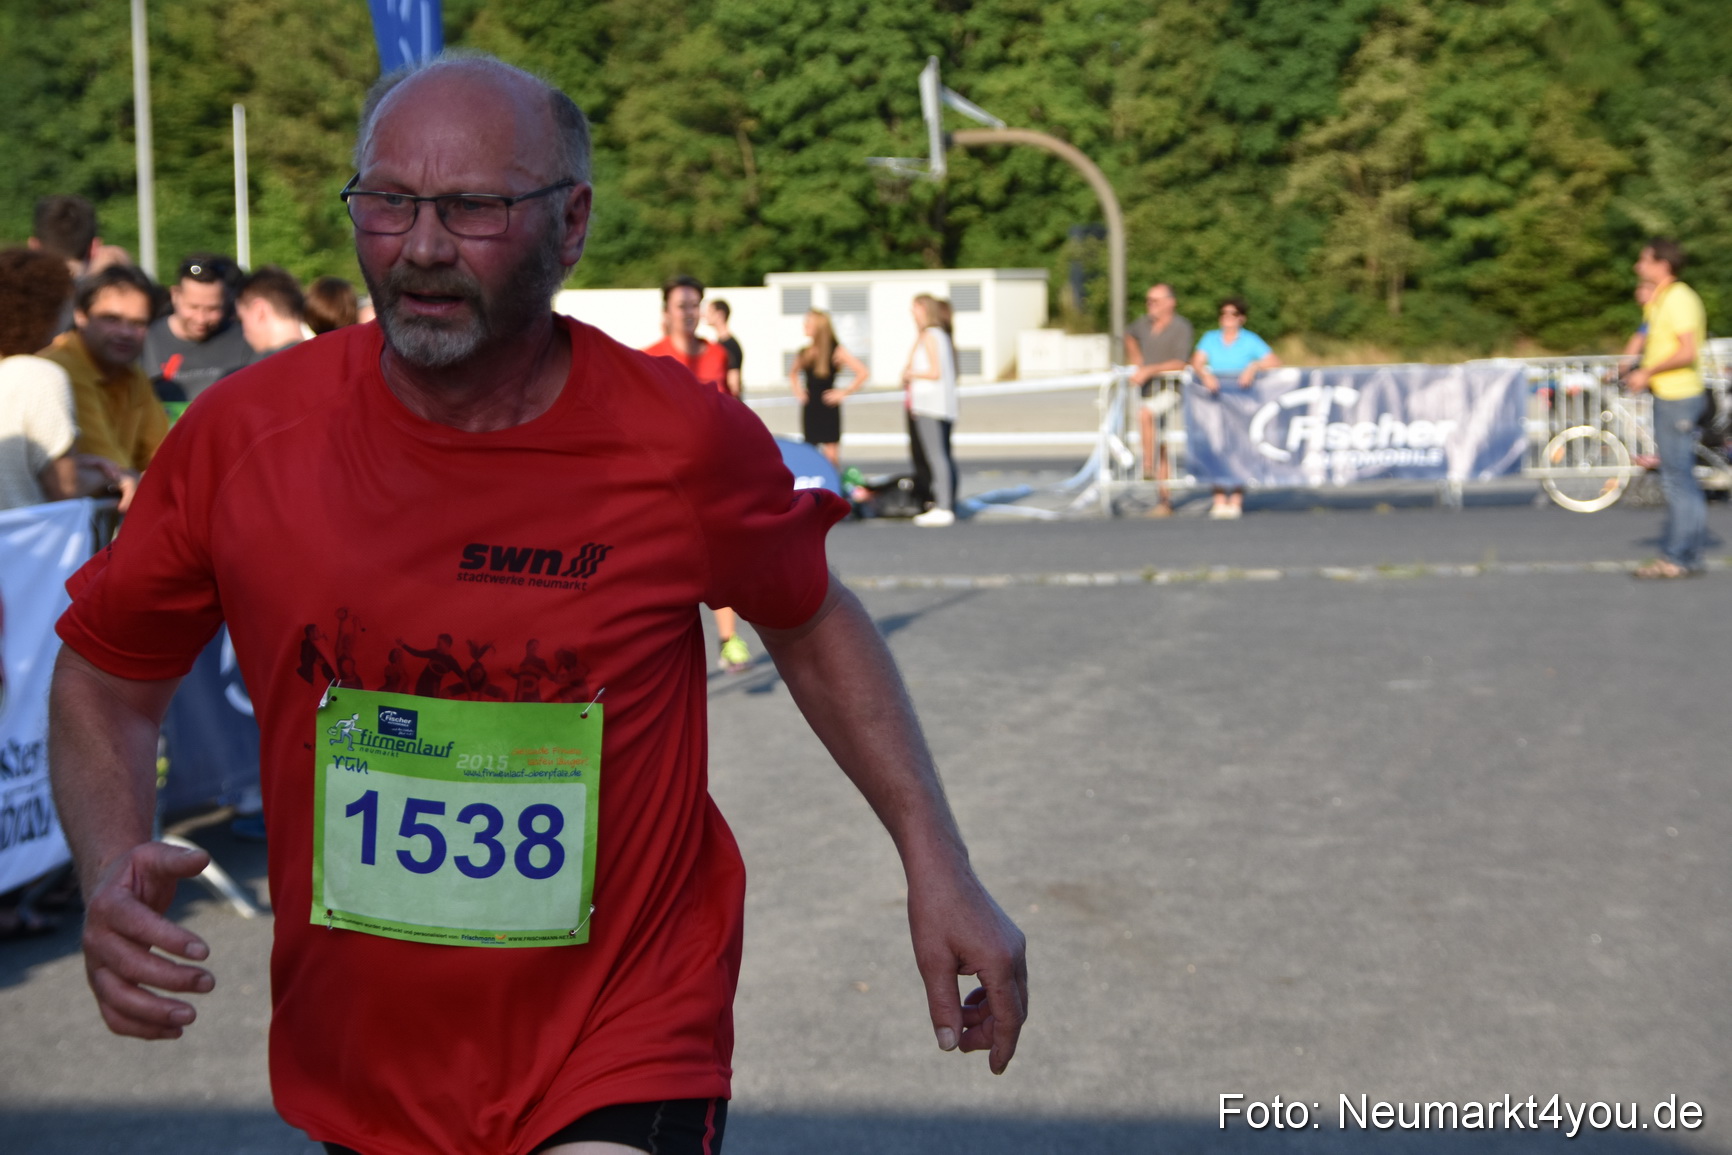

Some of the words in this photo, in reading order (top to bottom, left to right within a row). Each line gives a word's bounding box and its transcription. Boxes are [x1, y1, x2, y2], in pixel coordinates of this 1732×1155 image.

[1286, 411, 1458, 451] Fischer
[459, 543, 563, 577] swn
[456, 571, 525, 586] stadtwerke
[528, 576, 588, 591] neumarkt
[385, 714, 412, 724] Fischer
[359, 746, 399, 757] neumarkt
[360, 729, 455, 758] firmenlauf
[456, 754, 509, 771] 2015
[345, 789, 566, 880] 1538
[461, 934, 496, 942] Frischmann
